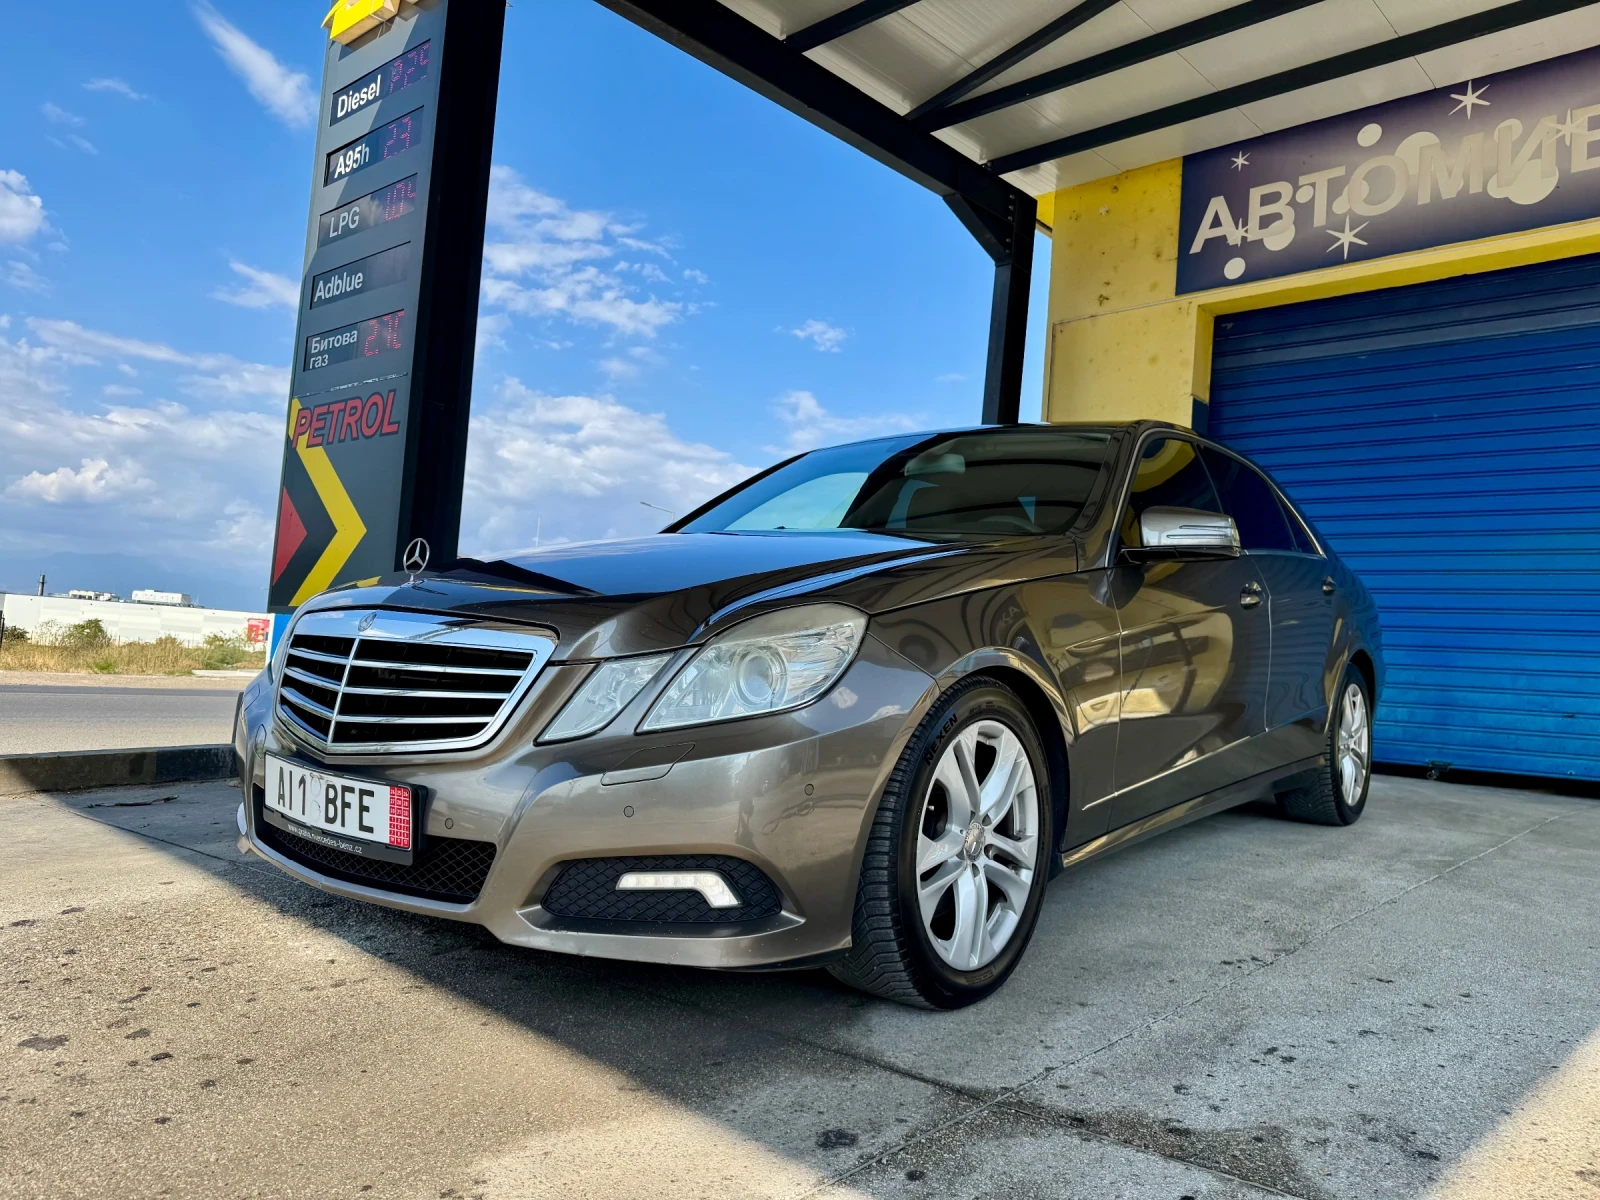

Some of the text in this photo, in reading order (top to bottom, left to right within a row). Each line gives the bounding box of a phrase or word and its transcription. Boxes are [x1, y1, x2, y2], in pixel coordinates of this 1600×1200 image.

[337, 74, 381, 118] Diesel
[334, 144, 370, 179] A95h
[329, 206, 360, 238] LPG
[314, 271, 364, 302] Adblue
[311, 329, 358, 354] Битова
[309, 354, 329, 369] газ
[291, 389, 400, 449] PETROL
[922, 712, 958, 767] NEXEN
[324, 784, 375, 834] BFE
